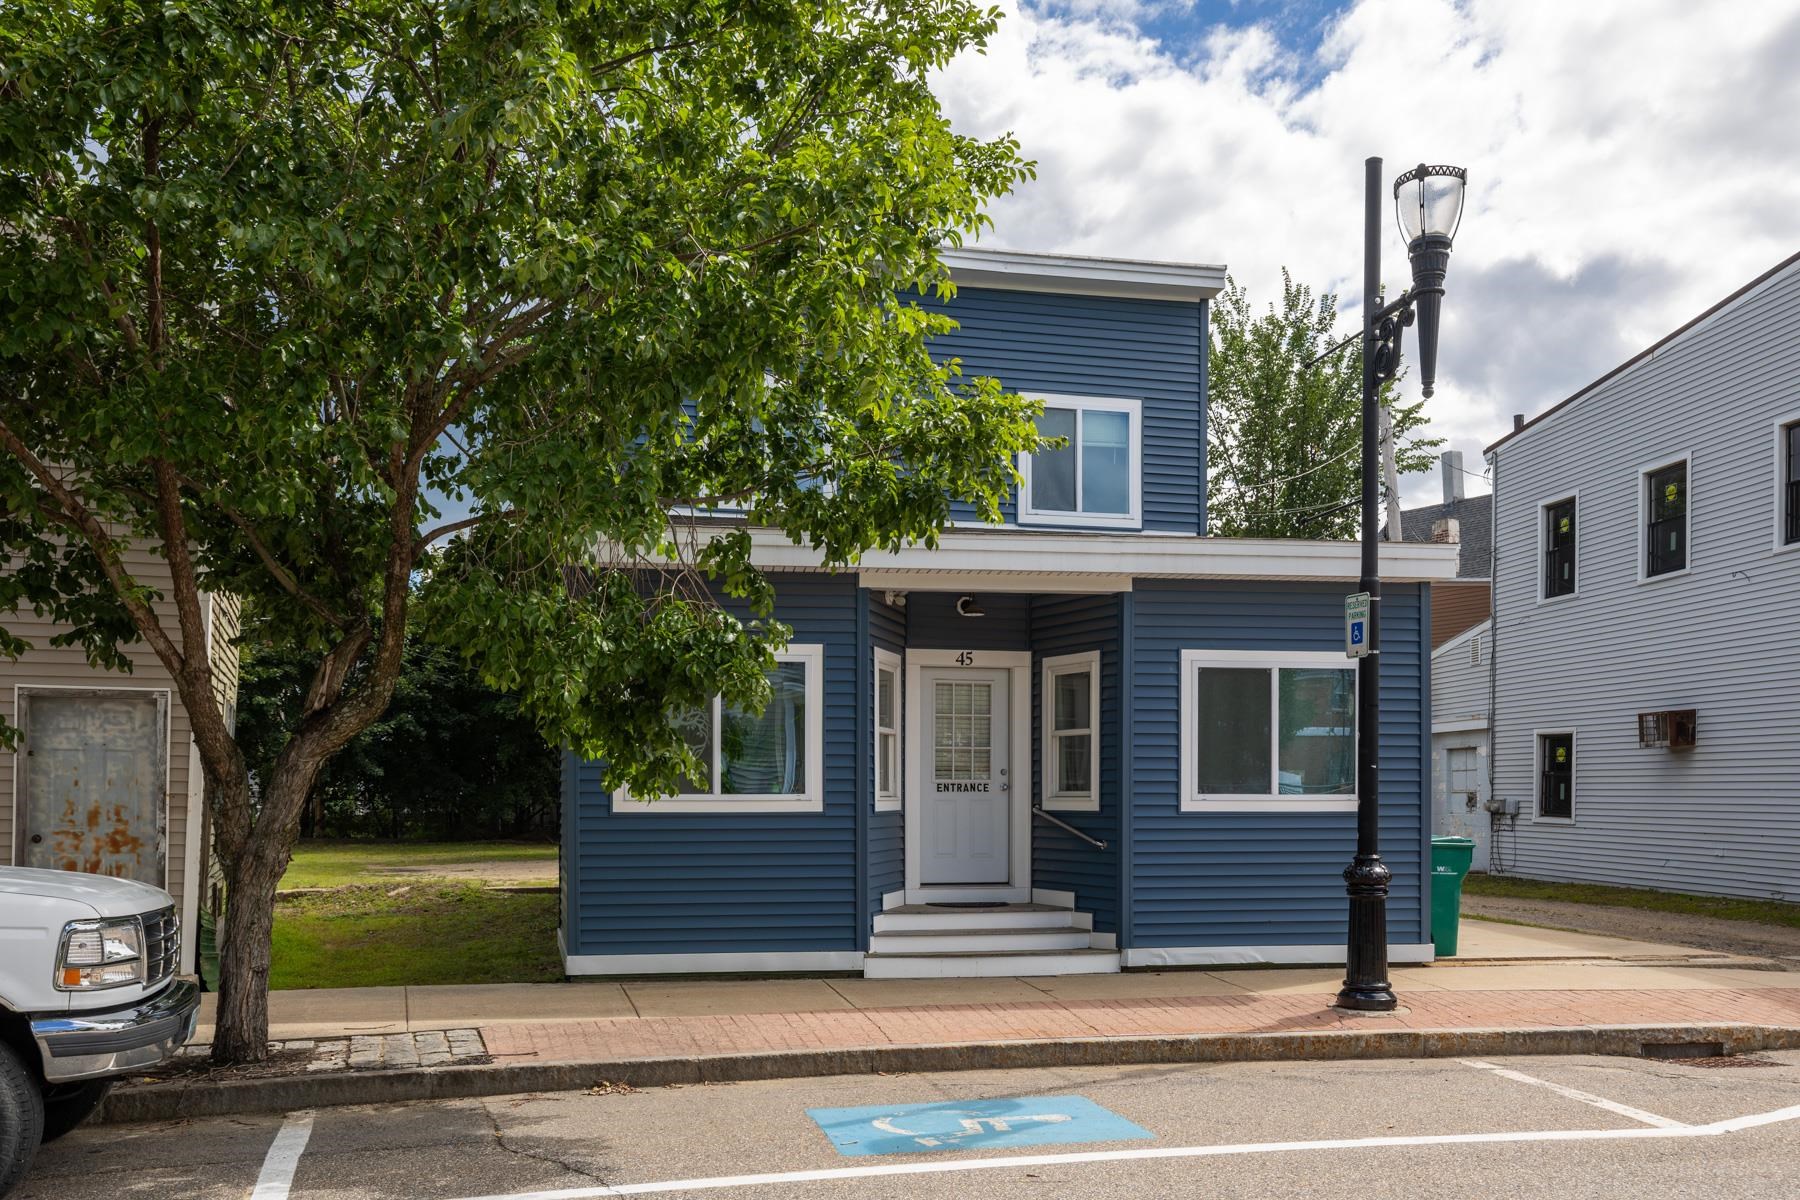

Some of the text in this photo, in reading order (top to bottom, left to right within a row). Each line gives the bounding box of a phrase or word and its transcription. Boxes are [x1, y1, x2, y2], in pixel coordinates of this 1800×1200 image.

[1347, 600, 1367, 610] RESERVED
[1348, 611, 1366, 620] PARKING
[955, 651, 974, 666] 45
[936, 783, 990, 793] ENTRANCE
